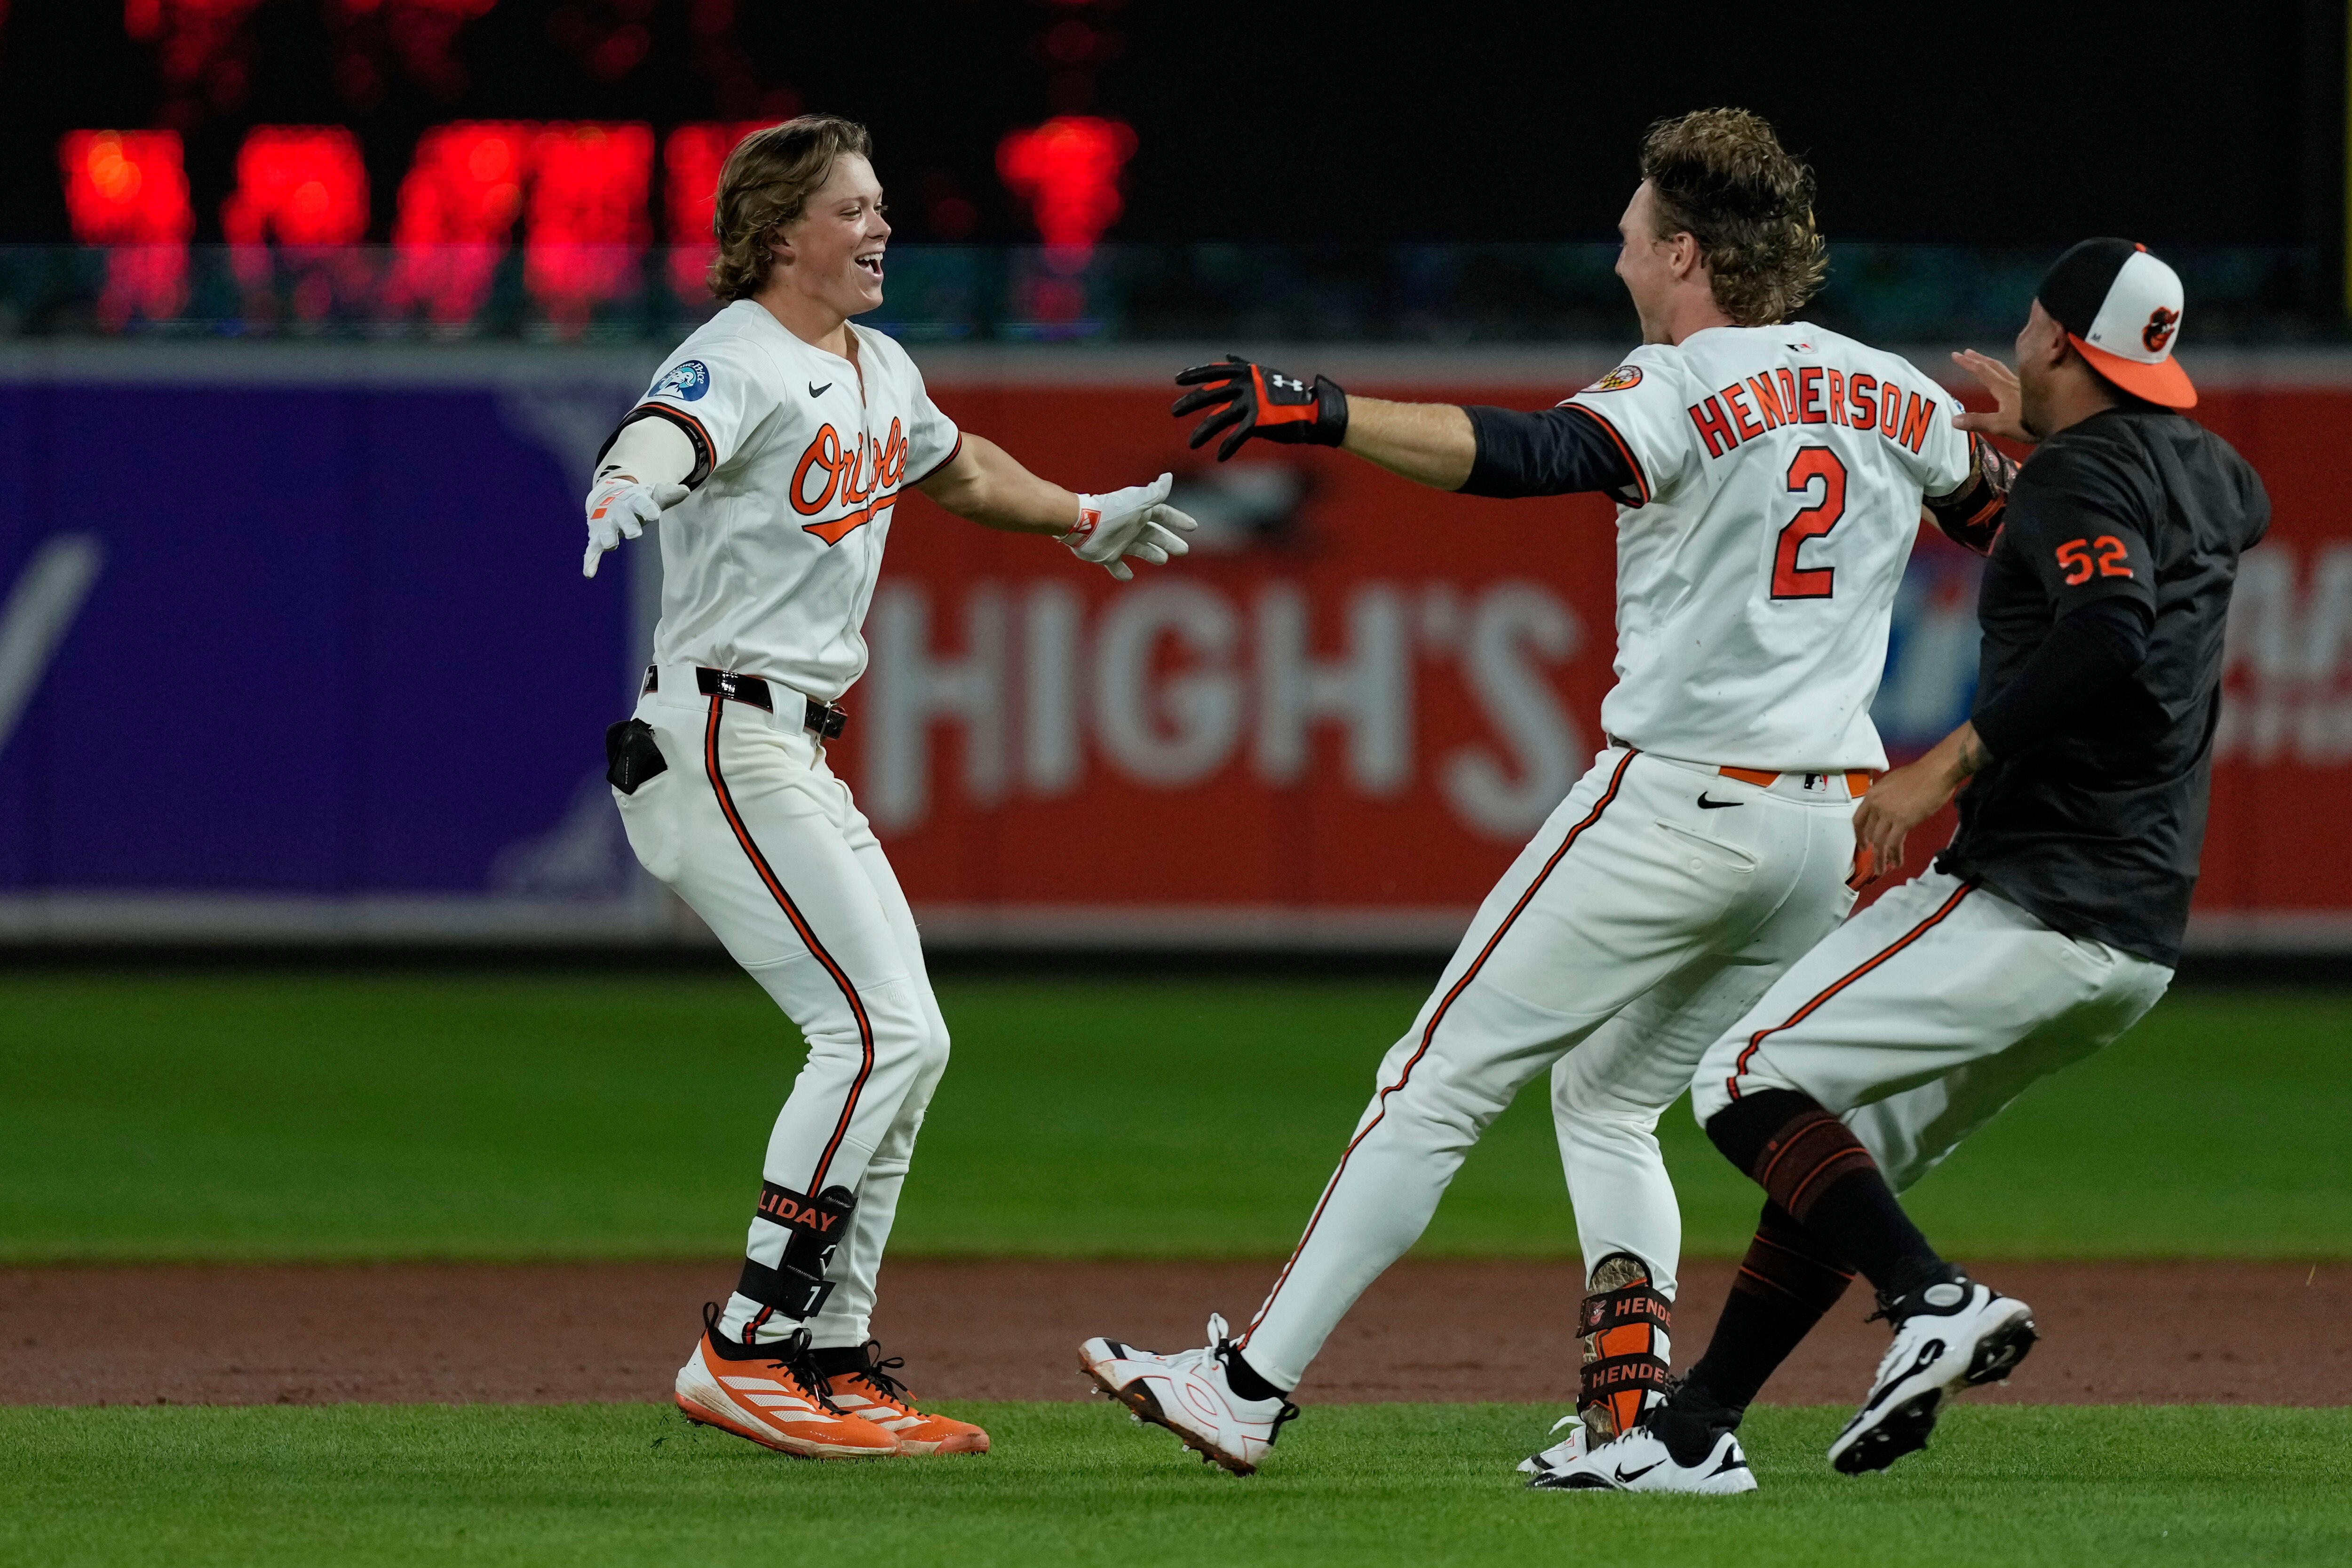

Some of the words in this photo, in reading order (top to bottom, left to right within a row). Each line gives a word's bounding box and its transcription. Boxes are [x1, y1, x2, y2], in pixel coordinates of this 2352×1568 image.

[1688, 367, 1936, 459] HENDERSON
[1770, 446, 1848, 600] 2
[2055, 535, 2134, 586] 52
[866, 579, 1586, 838] HIGH'S
[1592, 1363, 1668, 1388] HENDE
